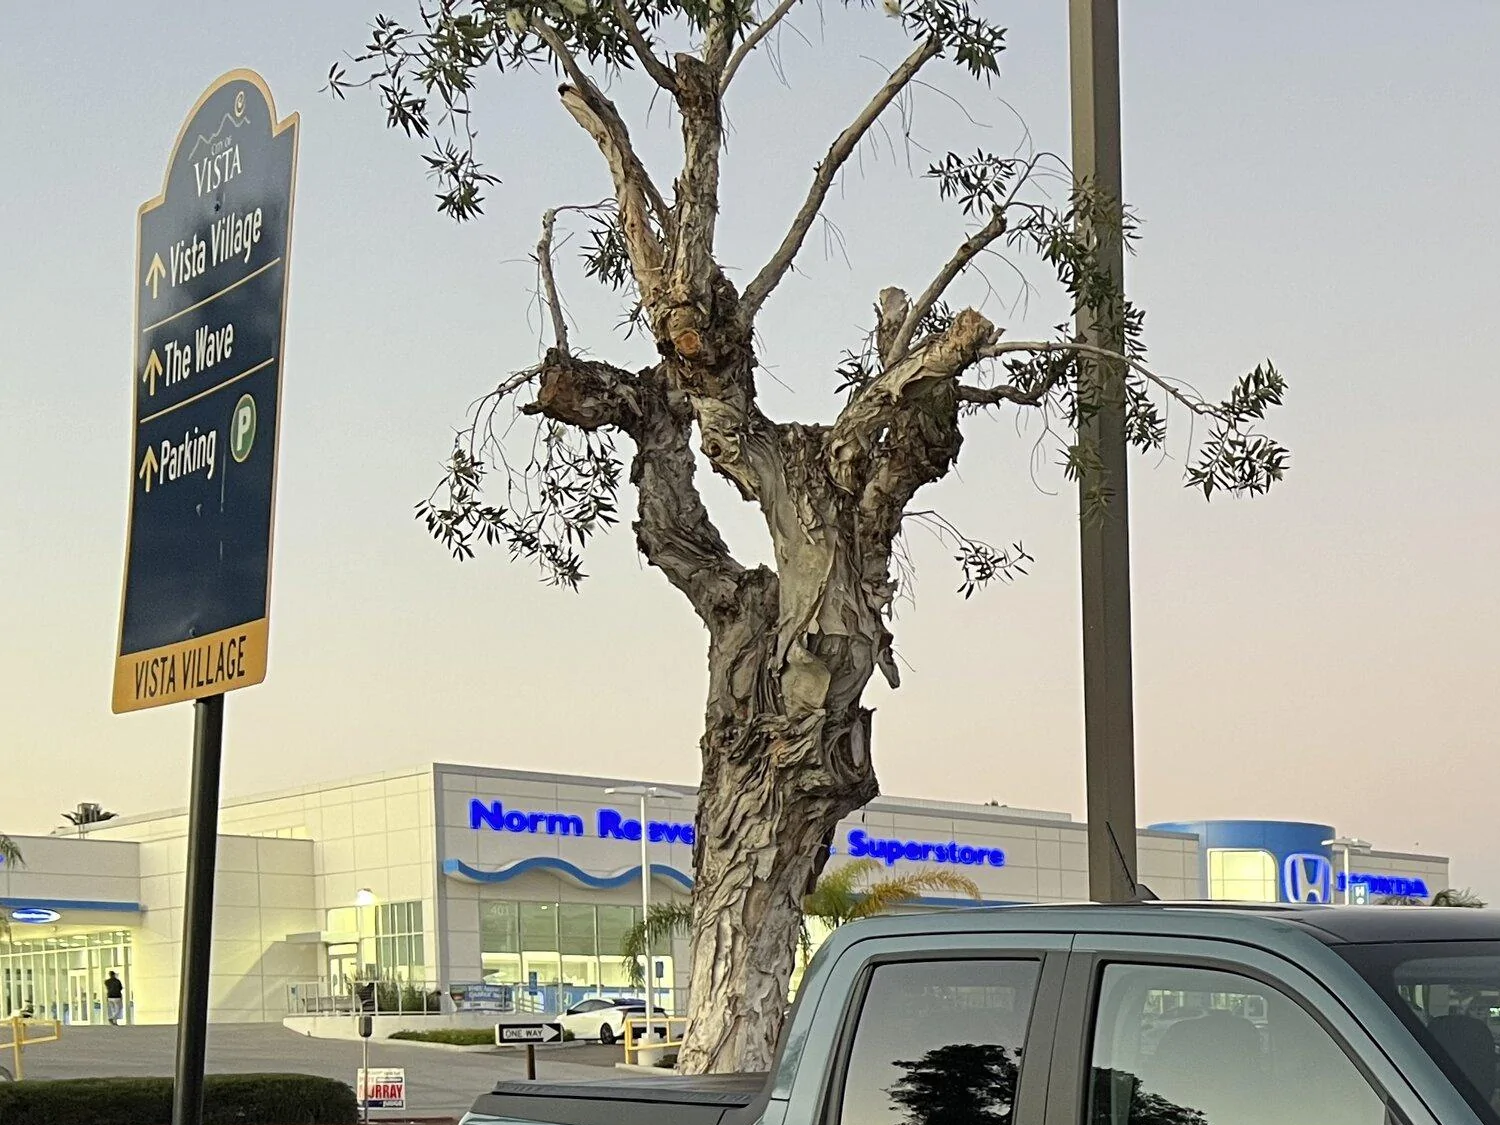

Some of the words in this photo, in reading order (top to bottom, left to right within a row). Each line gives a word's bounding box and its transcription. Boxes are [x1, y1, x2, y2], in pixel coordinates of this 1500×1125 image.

[193, 143, 242, 198] VISTA
[170, 233, 206, 288] Vista
[211, 207, 262, 264] Village
[164, 339, 190, 387] The
[195, 323, 233, 374] Wave
[159, 426, 217, 484] Parking
[135, 655, 176, 700] VISTA
[182, 635, 247, 690] VILLAGE
[470, 799, 583, 837] Norm
[848, 829, 1005, 867] Superstore
[505, 1029, 523, 1039] ONE
[525, 1029, 543, 1037] WAY
